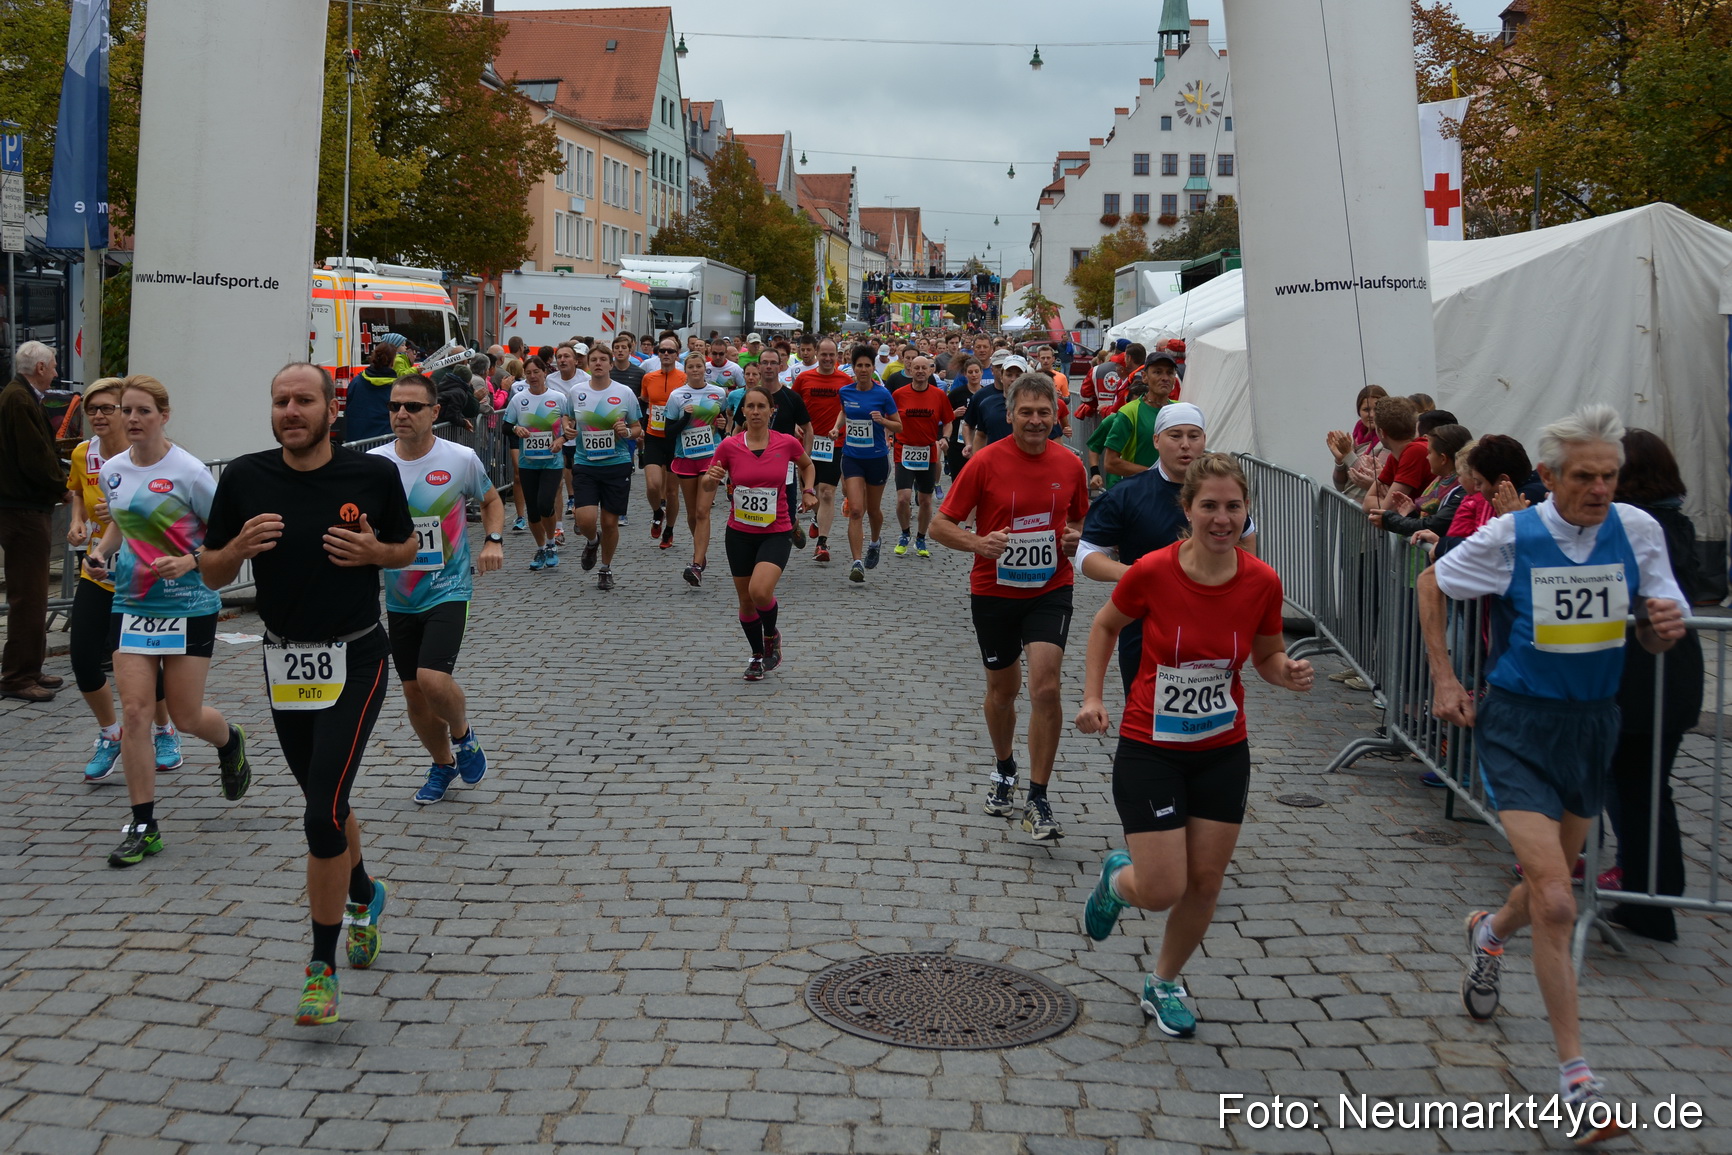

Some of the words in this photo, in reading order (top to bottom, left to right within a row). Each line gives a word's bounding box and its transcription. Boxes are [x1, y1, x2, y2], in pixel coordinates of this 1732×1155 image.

[6, 134, 18, 165] P
[135, 270, 280, 290] www.bmw-laufsport.de
[1275, 275, 1427, 296] www.bmw-laufsport.de
[553, 304, 591, 312] Bayerisches
[552, 319, 571, 327] Kreuz
[847, 425, 870, 437] 2551
[526, 438, 551, 450] 2394
[585, 437, 612, 450] 2660
[684, 432, 712, 448] 2528
[904, 450, 928, 461] 2239
[741, 495, 768, 511] 283
[744, 513, 764, 522] Kerstin
[1019, 537, 1048, 545] Neumarkt
[1002, 544, 1053, 567] 2206
[1007, 571, 1047, 582] Wolfgang
[1535, 576, 1567, 584] PARTL
[1569, 574, 1614, 584] Neumarkt
[1555, 587, 1609, 620] 521
[129, 613, 180, 633] 2822
[146, 637, 161, 647] Eva
[284, 652, 333, 681] 258
[1158, 671, 1186, 684] PARTL
[1187, 673, 1223, 684] Neumarkt
[298, 687, 322, 699] PuTo
[1163, 683, 1227, 715] 2205
[1181, 719, 1213, 732] Sarah
